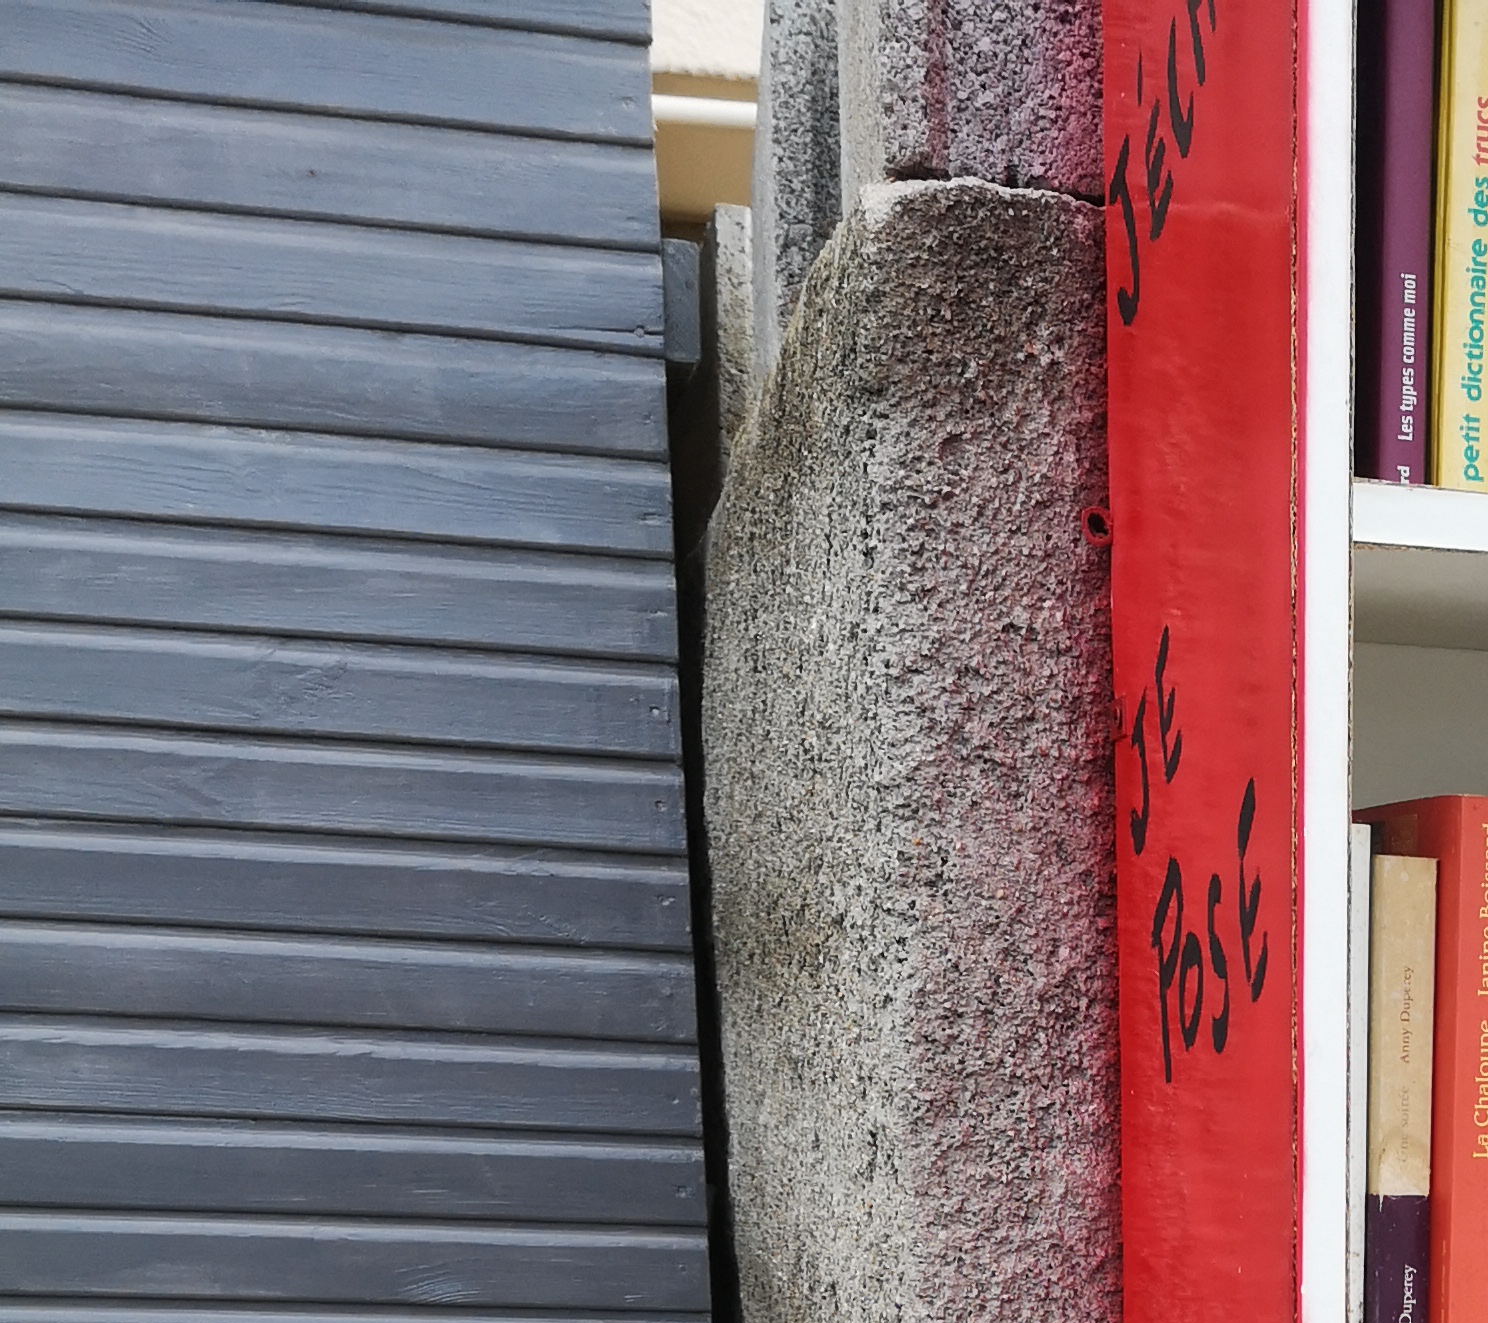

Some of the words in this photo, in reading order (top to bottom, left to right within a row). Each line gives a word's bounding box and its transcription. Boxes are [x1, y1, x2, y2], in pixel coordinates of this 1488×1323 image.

[1400, 272, 1417, 305] moi
[1400, 307, 1417, 365] comme
[1460, 237, 1488, 402] dictionnaire
[1399, 367, 1418, 412] types
[1397, 416, 1414, 442] Les
[1459, 412, 1484, 482] petit
